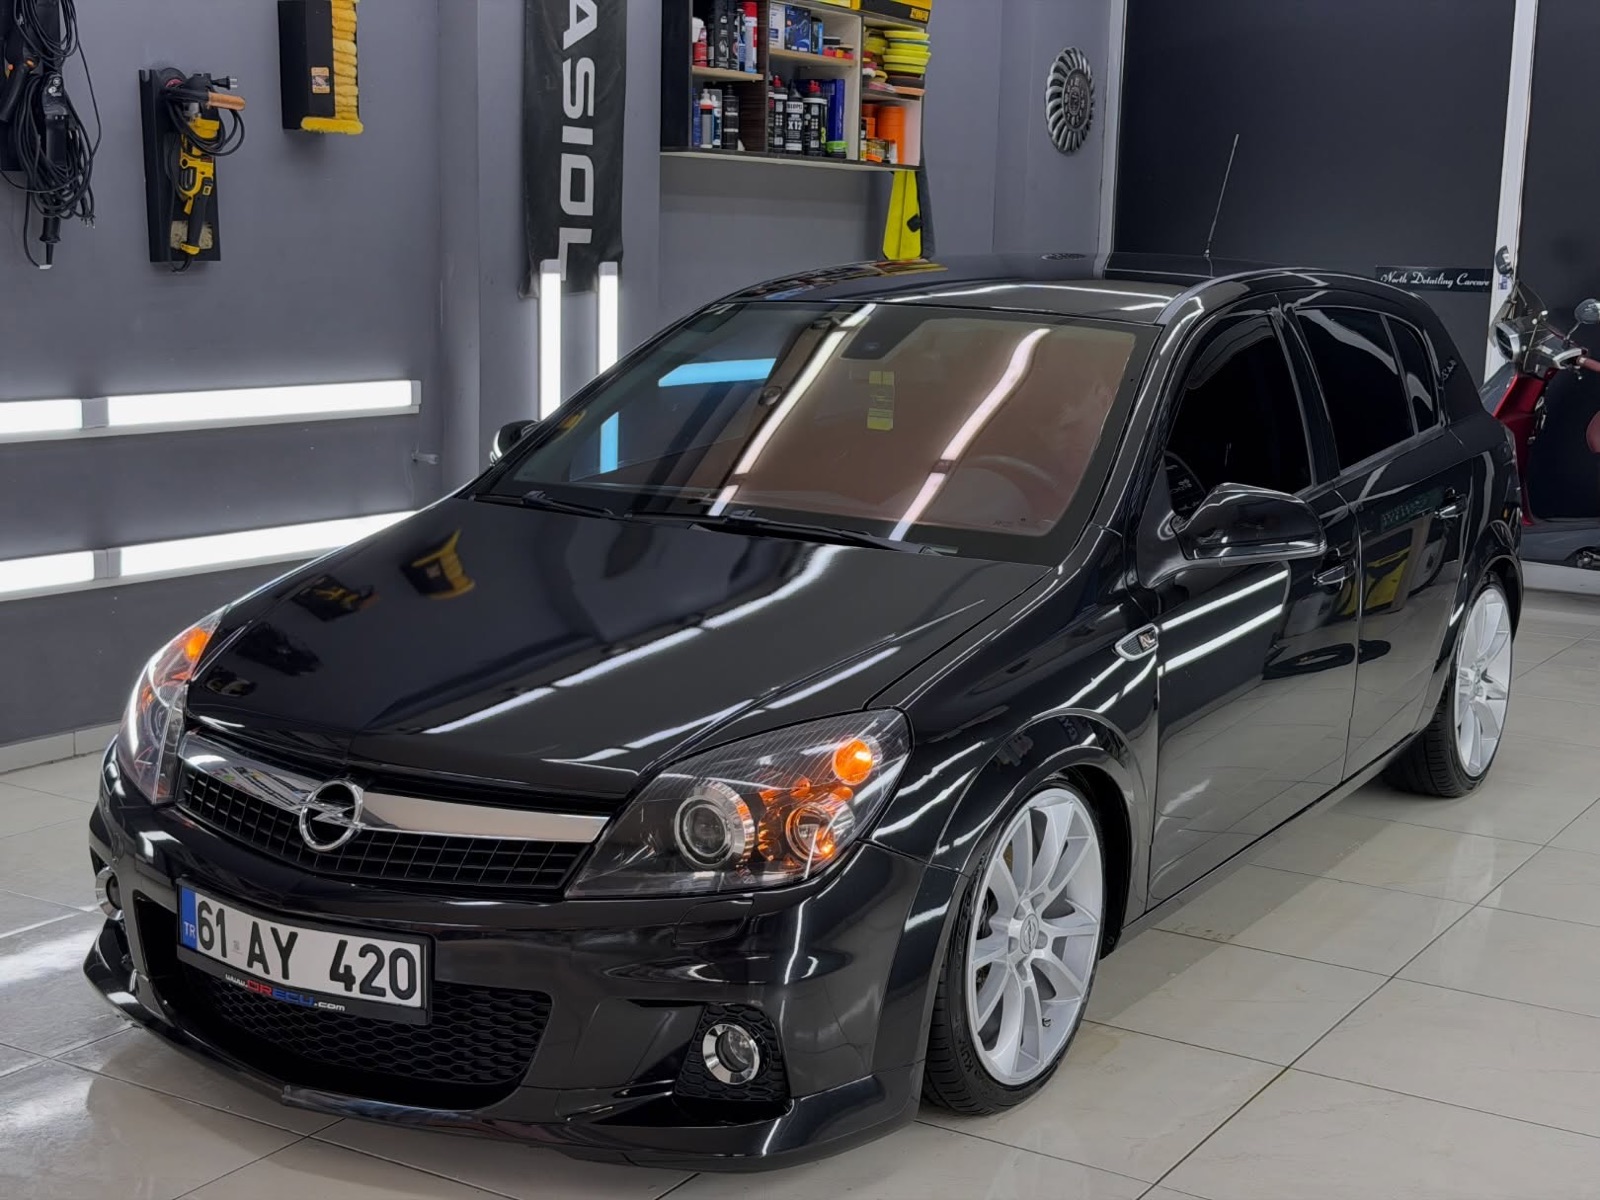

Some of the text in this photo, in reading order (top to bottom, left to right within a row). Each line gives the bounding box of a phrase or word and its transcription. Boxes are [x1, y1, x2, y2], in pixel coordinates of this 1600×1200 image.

[1380, 271, 1407, 284] North
[1410, 271, 1454, 288] Detailing
[183, 921, 197, 940] TR
[197, 900, 417, 1001] 61 AY 420
